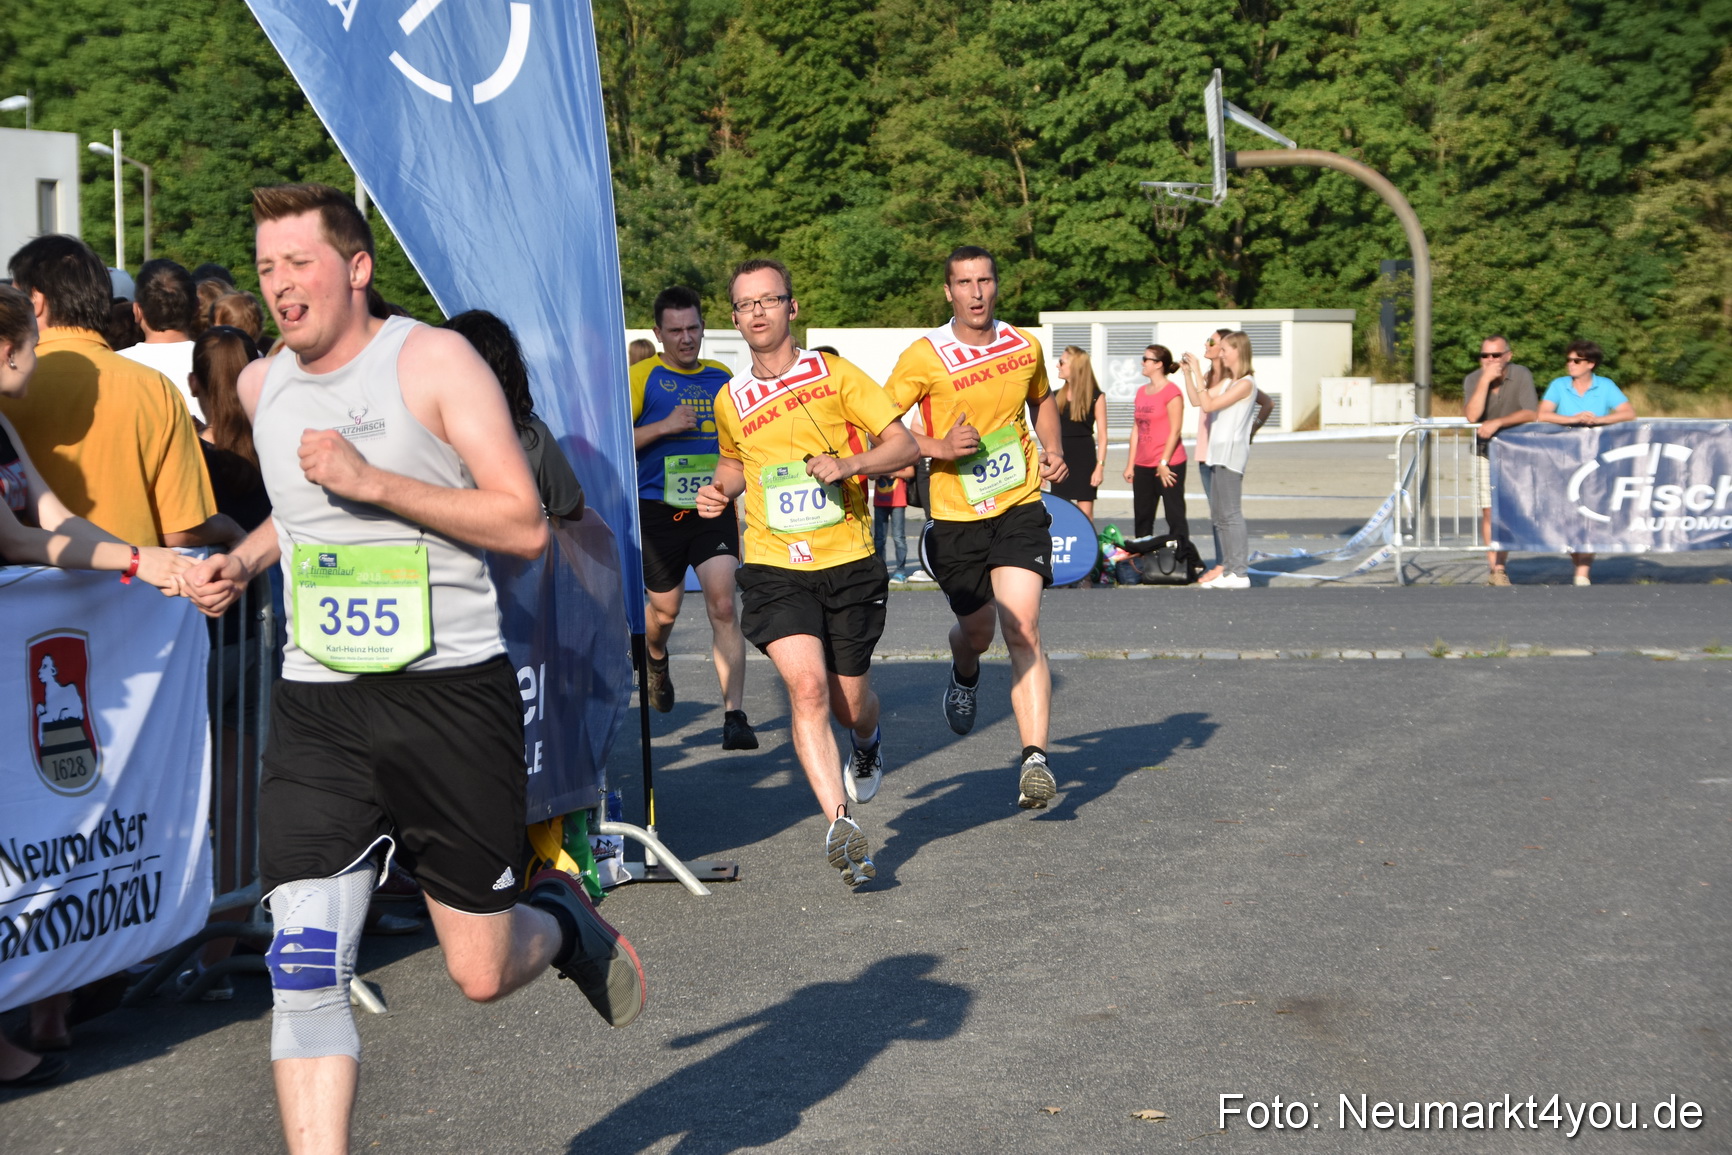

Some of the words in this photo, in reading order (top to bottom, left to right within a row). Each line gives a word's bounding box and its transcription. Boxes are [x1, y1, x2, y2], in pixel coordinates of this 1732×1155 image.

[952, 367, 994, 391] MAX
[996, 352, 1036, 375] BÖGL
[742, 405, 781, 438] MAX
[784, 383, 837, 412] BÖGL
[337, 421, 385, 434] ATZHIRSCH
[972, 452, 1014, 483] 932
[779, 487, 827, 514] 870
[1609, 475, 1732, 512] Fisch
[1052, 536, 1077, 551] er
[319, 596, 401, 636] 355
[326, 645, 366, 653] Karl-Heinz
[367, 645, 394, 653] Hotter
[52, 755, 87, 782] 1628
[525, 741, 543, 775] E
[0, 809, 147, 888] Neumrkter
